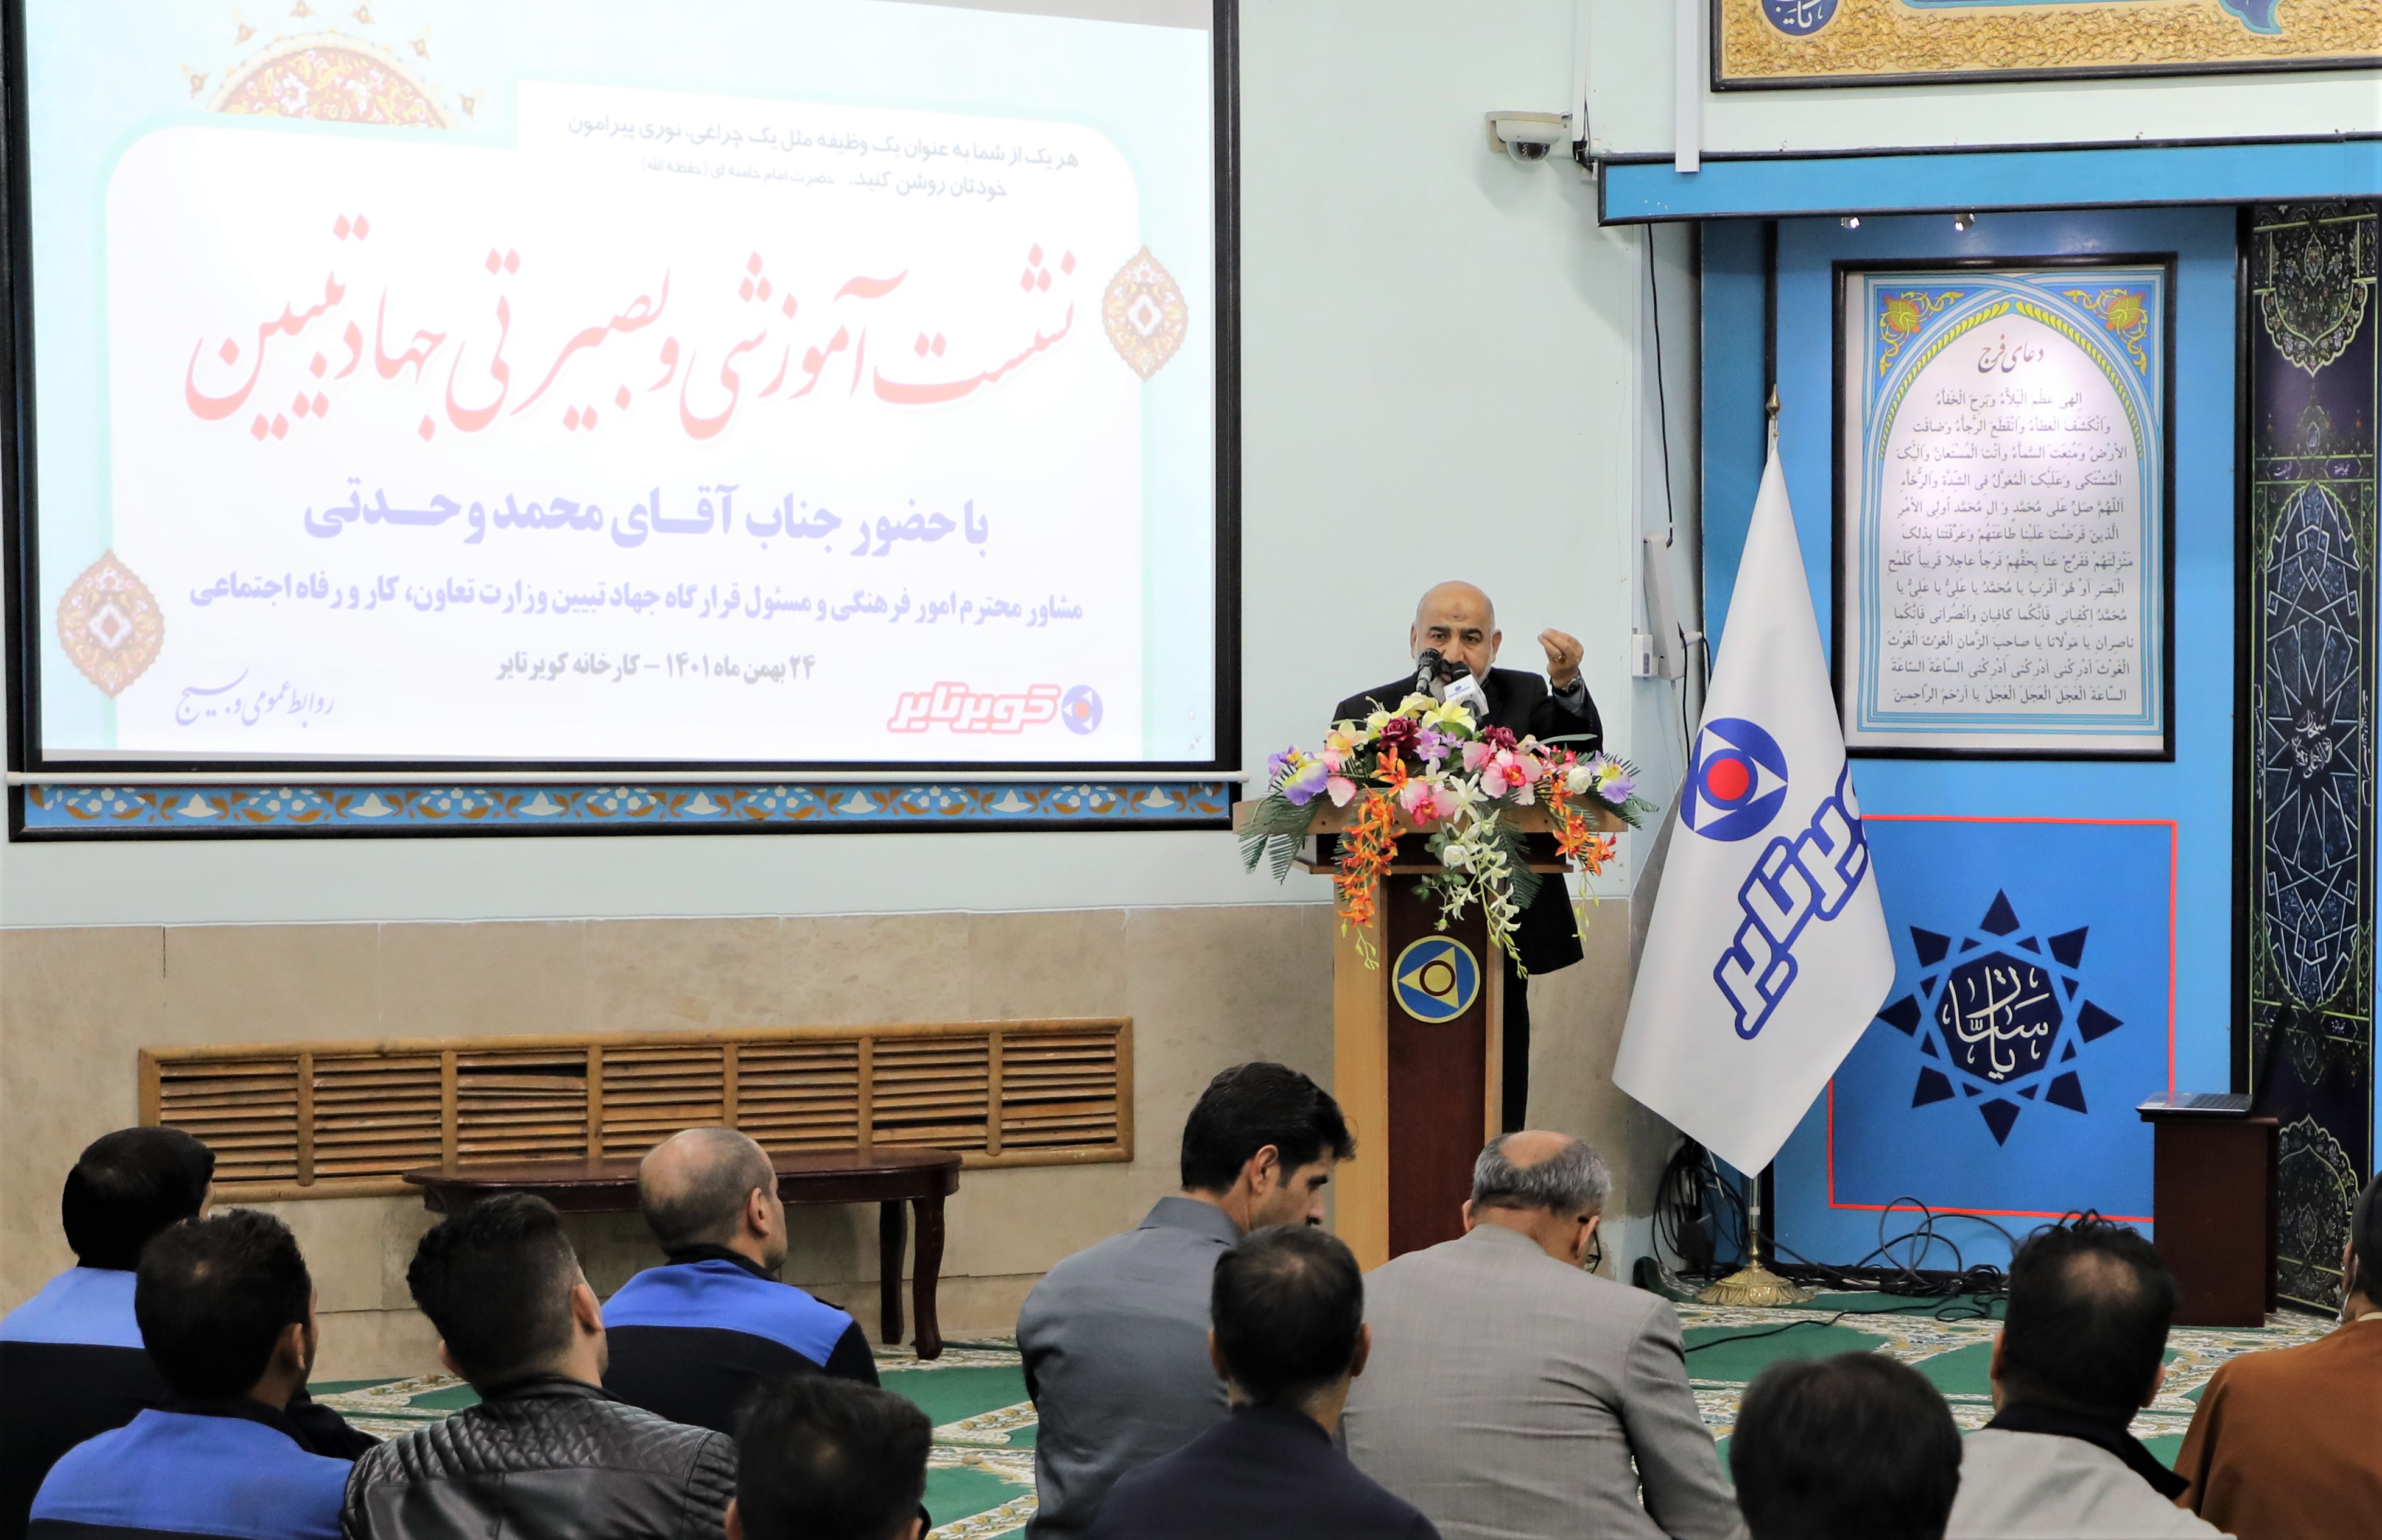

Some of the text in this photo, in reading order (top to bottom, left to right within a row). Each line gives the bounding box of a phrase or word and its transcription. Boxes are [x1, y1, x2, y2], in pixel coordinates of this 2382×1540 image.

[569, 115, 633, 141] پیرامون
[639, 124, 681, 143] نوری
[749, 126, 777, 149] یک
[781, 128, 812, 151] مثل
[818, 133, 868, 156] وظیفه
[873, 137, 899, 158] یک
[905, 139, 949, 161] عنوان
[954, 144, 969, 163] به
[974, 142, 1005, 161] شما
[1008, 146, 1021, 166] از
[1025, 149, 1052, 170] یک
[1056, 151, 1078, 170] هر
[764, 168, 787, 186] امام
[790, 172, 834, 186] حضرت
[849, 172, 1007, 202] خودتان روشن کنید.
[185, 212, 370, 443] تبیین
[873, 241, 1076, 405] نشست
[445, 247, 670, 433] بصیرتی
[680, 250, 908, 440] آموزشی
[1978, 334, 2044, 373] دعای فرج
[334, 286, 447, 443] جهاد
[493, 493, 604, 532] محمد
[746, 492, 843, 554] جناب
[850, 498, 957, 557] حضور
[964, 498, 989, 558] با
[190, 571, 292, 607] اجتماعی
[296, 569, 343, 610] رفاه
[346, 588, 360, 610] و
[364, 575, 400, 610] کار
[406, 577, 475, 612] تعاون،
[479, 579, 548, 615] وزارت
[552, 582, 605, 614] تبیین
[609, 581, 661, 616] جهاد
[1897, 581, 1904, 594] یا
[1934, 582, 1941, 594] یا
[1972, 582, 1978, 595] یا
[2017, 582, 2024, 595] یا
[745, 586, 811, 621] مسئول
[815, 599, 827, 621] و
[831, 586, 910, 622] فرهنگی
[915, 591, 957, 624] امور
[960, 596, 1022, 625] محترم
[1025, 594, 1083, 627] مشاور
[2035, 636, 2042, 649] یا
[2084, 636, 2090, 650] یا
[572, 652, 641, 683] کارخانه
[667, 652, 711, 680] ۱۴۰۱
[714, 654, 740, 677] ماه
[744, 656, 786, 684] بهمن
[790, 653, 816, 680] ۲۴
[242, 681, 292, 727] عمومی
[286, 688, 334, 728] روابط
[887, 680, 1063, 735] کویرتایر
[1973, 688, 1980, 701] یا
